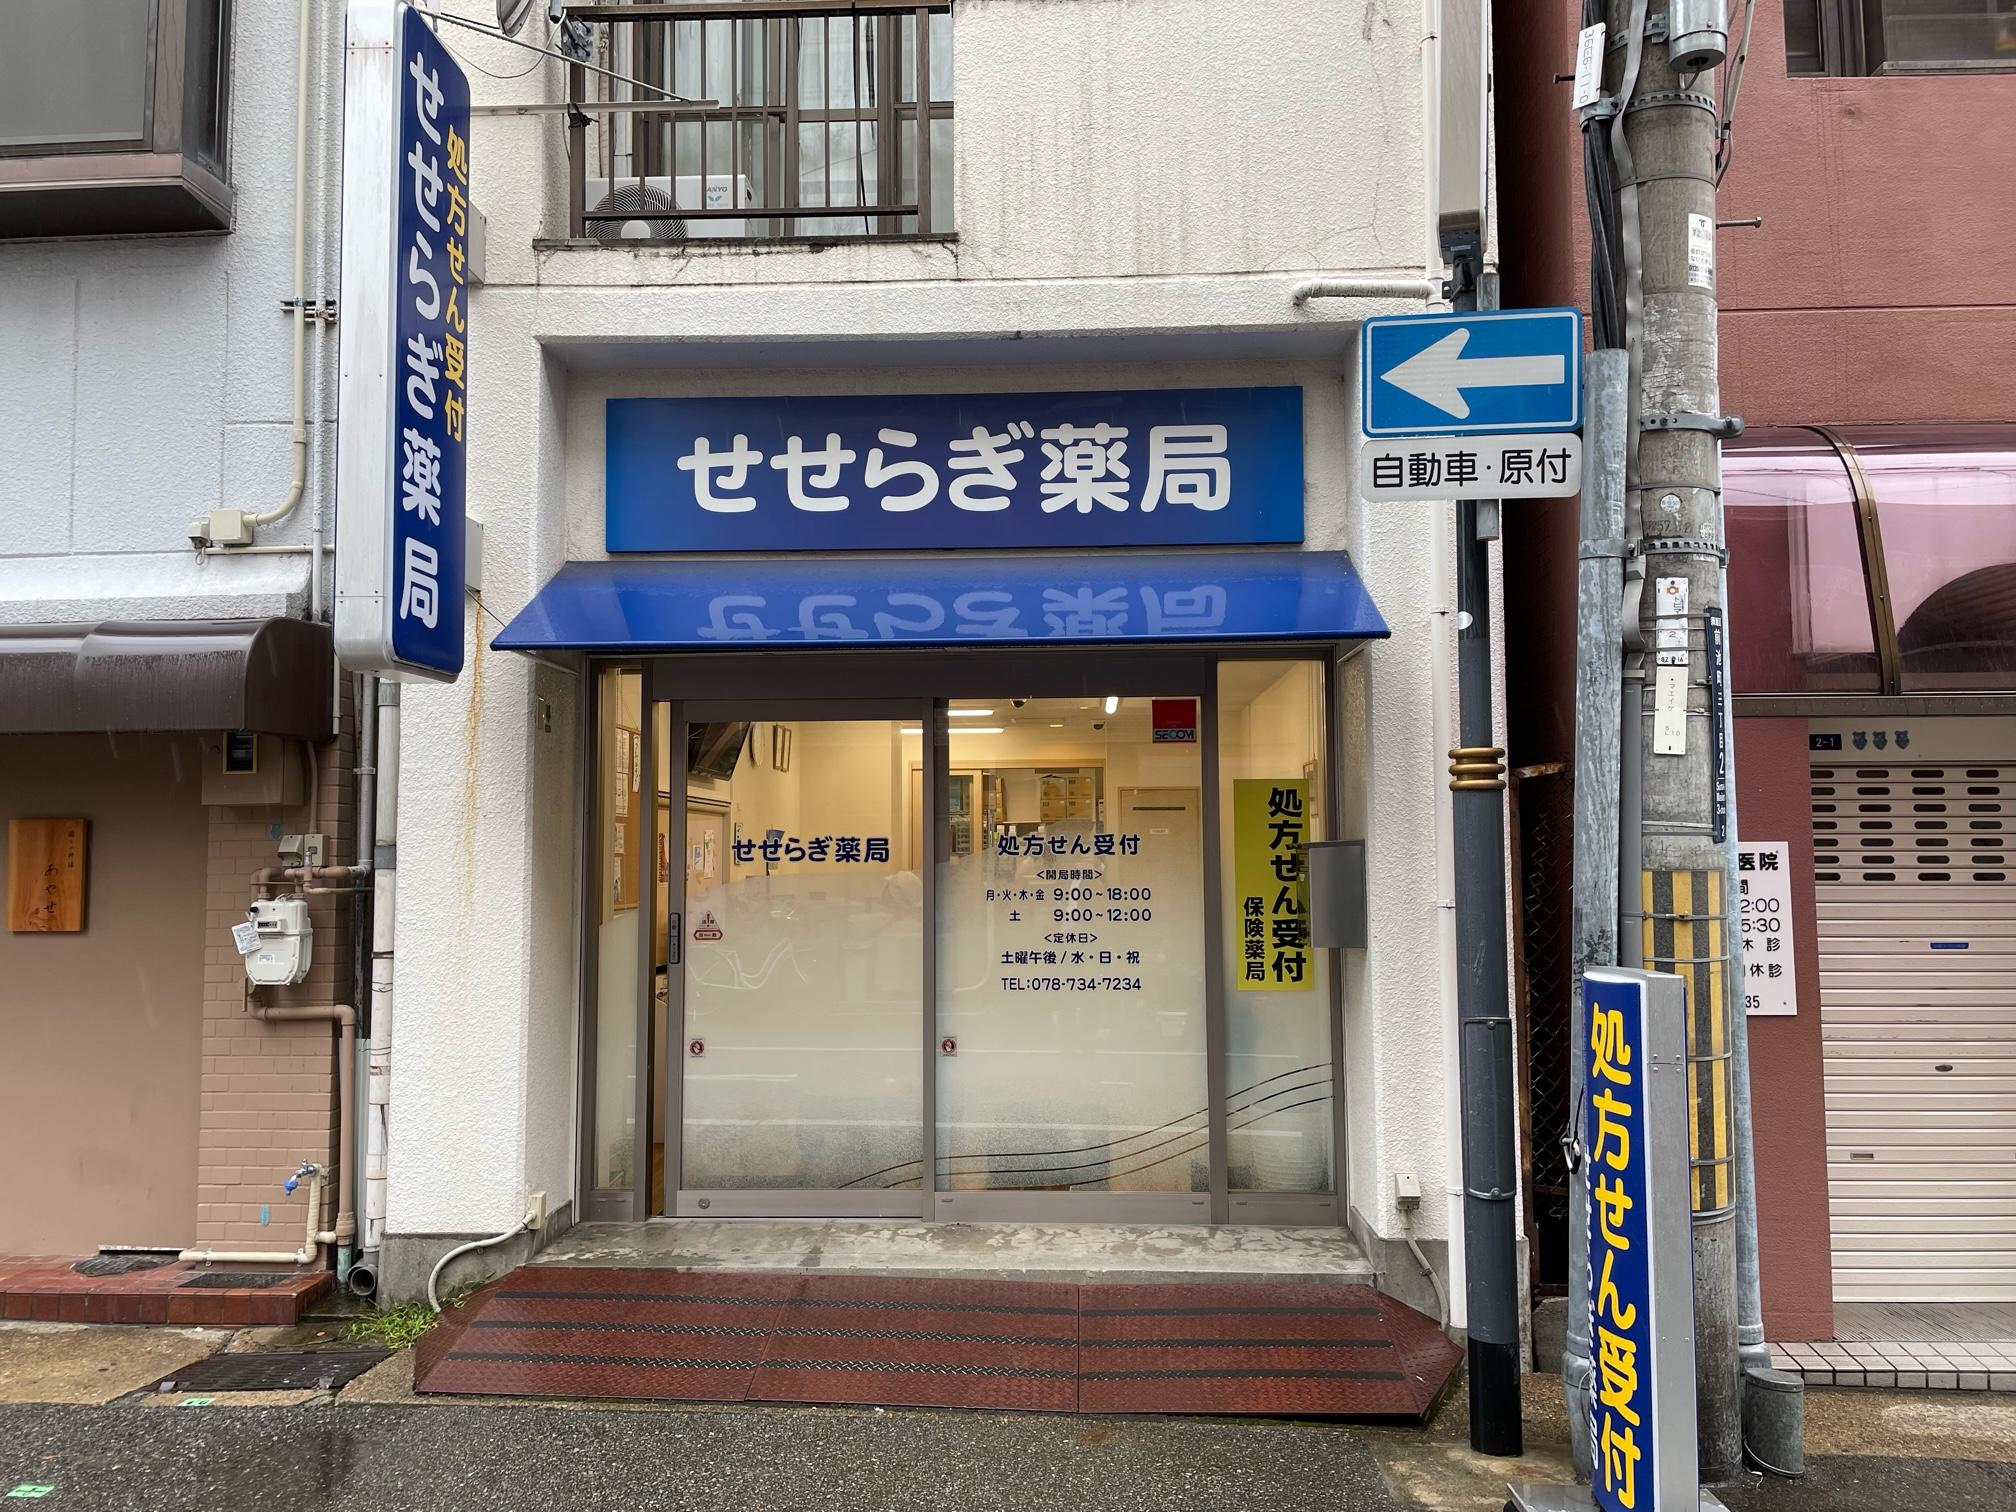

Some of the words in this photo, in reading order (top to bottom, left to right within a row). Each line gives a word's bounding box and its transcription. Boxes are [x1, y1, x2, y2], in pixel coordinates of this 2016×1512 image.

[445, 124, 468, 442] 処方せん受付
[400, 52, 444, 629] せせらぎ薬局
[677, 421, 1232, 514] せせらぎ薬局
[1373, 448, 1572, 488] 自動車・原付
[1155, 729, 1194, 740] SECOM
[1815, 738, 1834, 748] 2-1
[732, 836, 889, 863] せせらぎ薬局
[998, 833, 1140, 856] 処方せん受付
[1738, 852, 1779, 871] 医院
[1268, 787, 1307, 983] 処方せん受付
[1009, 909, 1022, 922] 土
[1243, 896, 1265, 982] 保険薬局
[1744, 963, 1783, 978] 休診
[1002, 977, 1142, 991] TEL:078-734-7234
[1745, 995, 1760, 1008] 35
[1591, 1002, 1643, 1510] 処方せん受付
